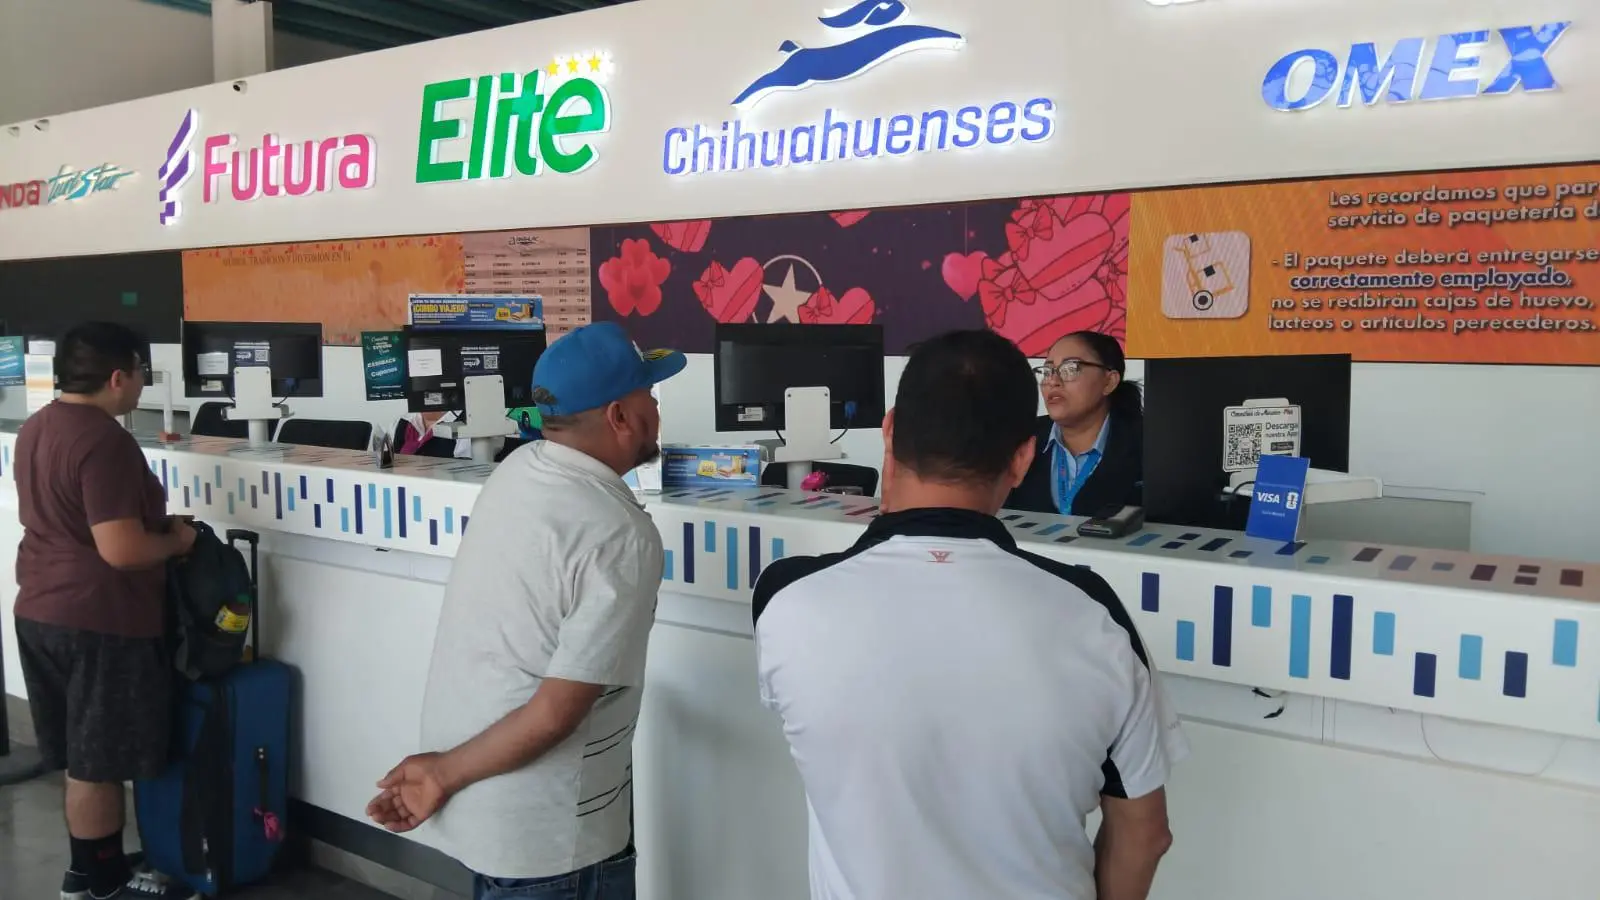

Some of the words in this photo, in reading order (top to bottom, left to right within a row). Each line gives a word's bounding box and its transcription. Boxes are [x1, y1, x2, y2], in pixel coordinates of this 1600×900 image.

[1261, 21, 1571, 112] OMEX
[414, 69, 611, 183] Elite
[663, 97, 1055, 176] Chihuahuenses
[203, 133, 373, 203] Futura
[1329, 191, 1361, 205] Les
[1368, 185, 1496, 204] recordamos
[1504, 185, 1547, 201] que
[1556, 181, 1600, 200] par
[1328, 209, 1406, 227] servicio
[1414, 208, 1440, 224] de
[1448, 201, 1574, 226] paquetería
[1583, 200, 1600, 217] d
[1284, 252, 1298, 266] El
[1305, 252, 1387, 270] paquete
[1395, 248, 1469, 264] deberá
[1477, 247, 1600, 266] entregarse
[1290, 271, 1436, 289] correctamente
[1271, 298, 1294, 309] no
[1302, 297, 1321, 308] se
[1328, 292, 1416, 308] recibirán
[1424, 292, 1477, 311] cajas
[1485, 291, 1511, 307] de
[1520, 291, 1594, 309] huevo,
[1268, 314, 1334, 329] lacteos
[1341, 318, 1353, 329] o
[1453, 313, 1596, 333] perecederos.
[1265, 422, 1299, 431] Descarga
[1257, 492, 1280, 504] VISA
